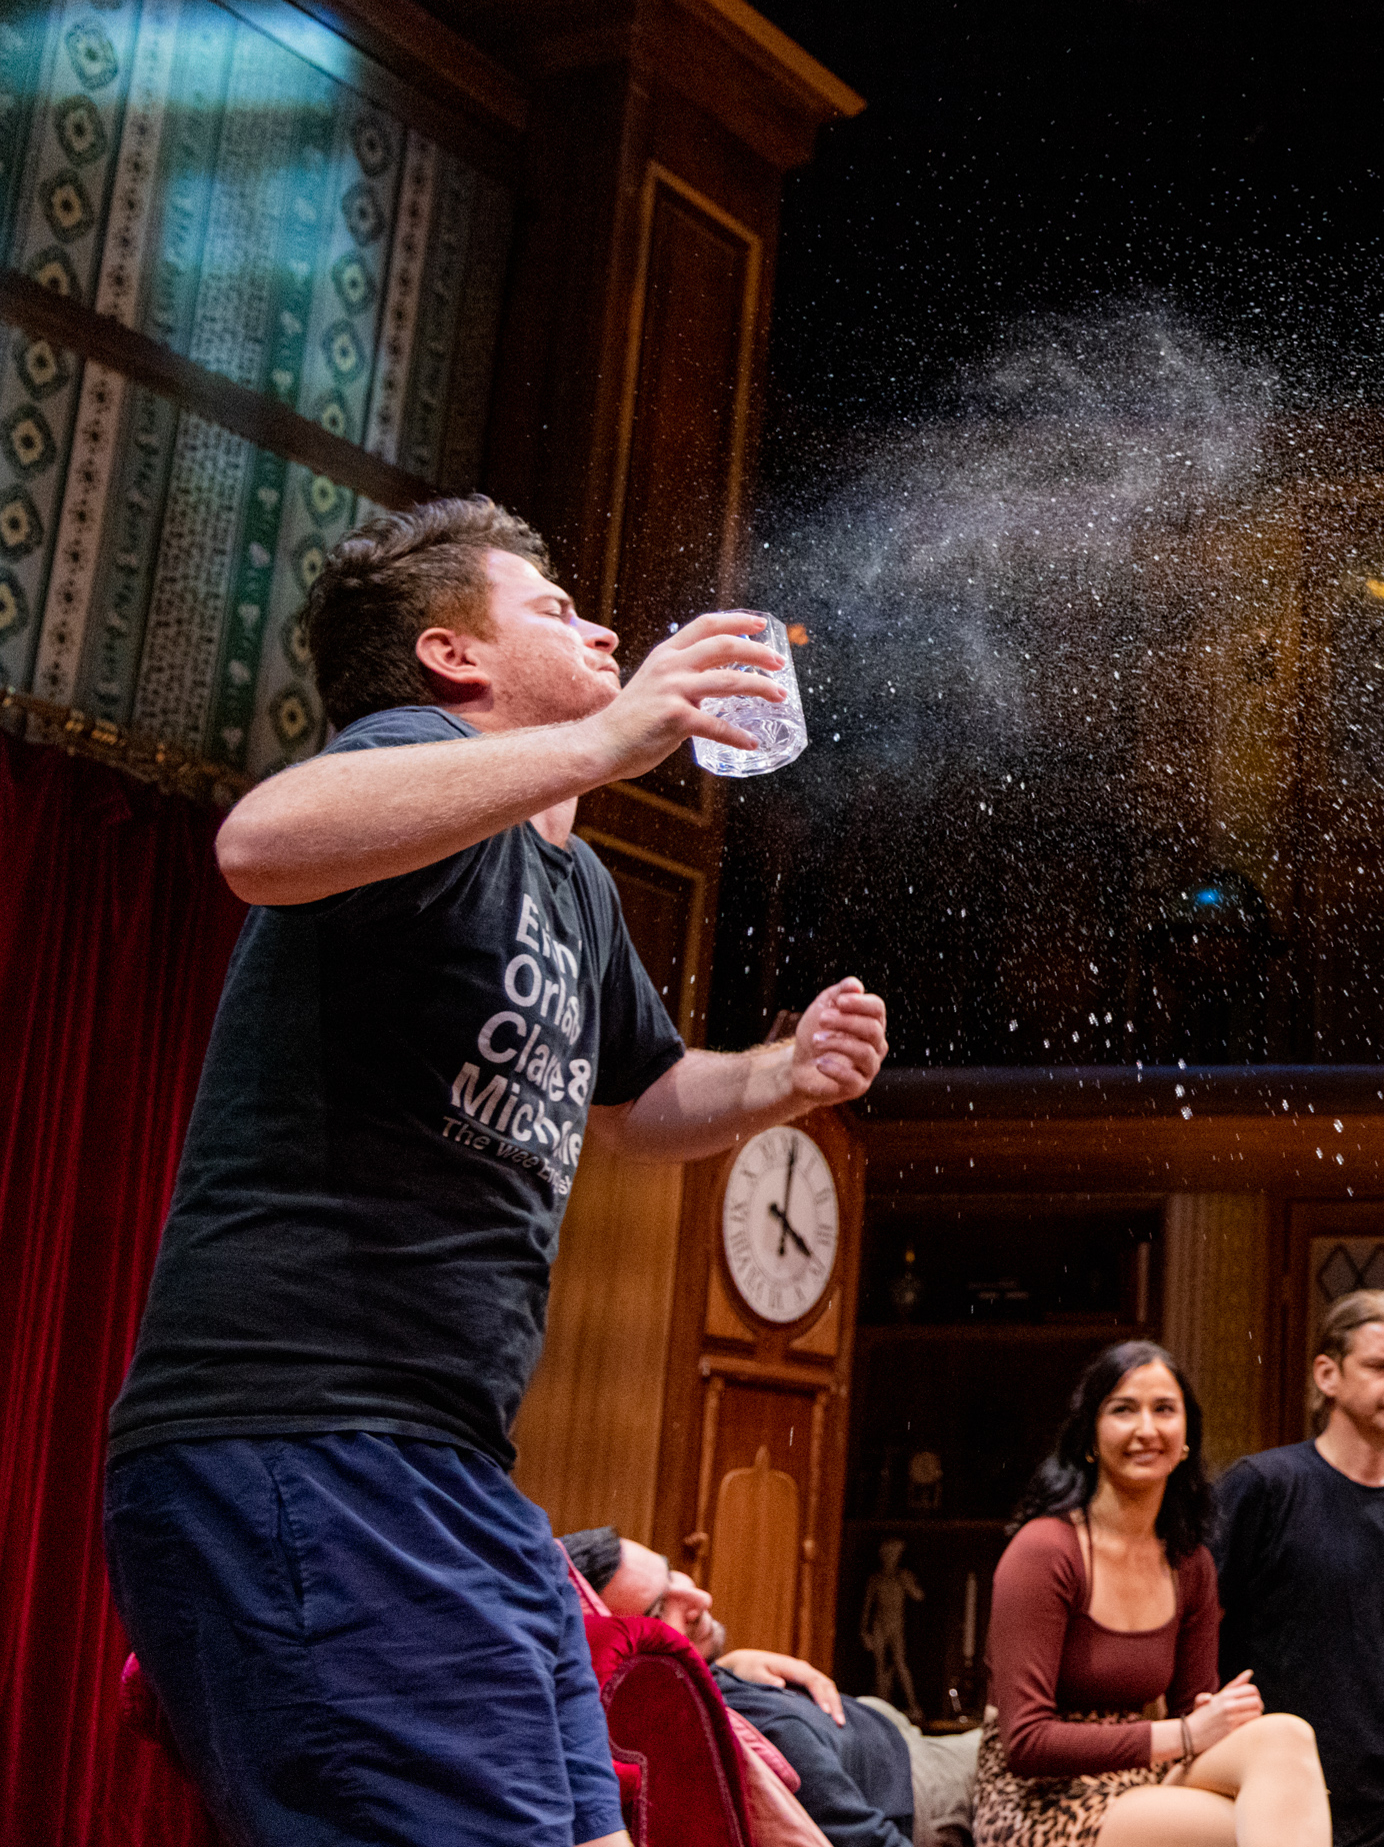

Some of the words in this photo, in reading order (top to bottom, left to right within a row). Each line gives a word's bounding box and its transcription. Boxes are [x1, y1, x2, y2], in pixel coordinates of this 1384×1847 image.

[477, 1010, 566, 1102] Clare
[442, 1116, 491, 1150] The
[495, 1141, 539, 1169] wee
